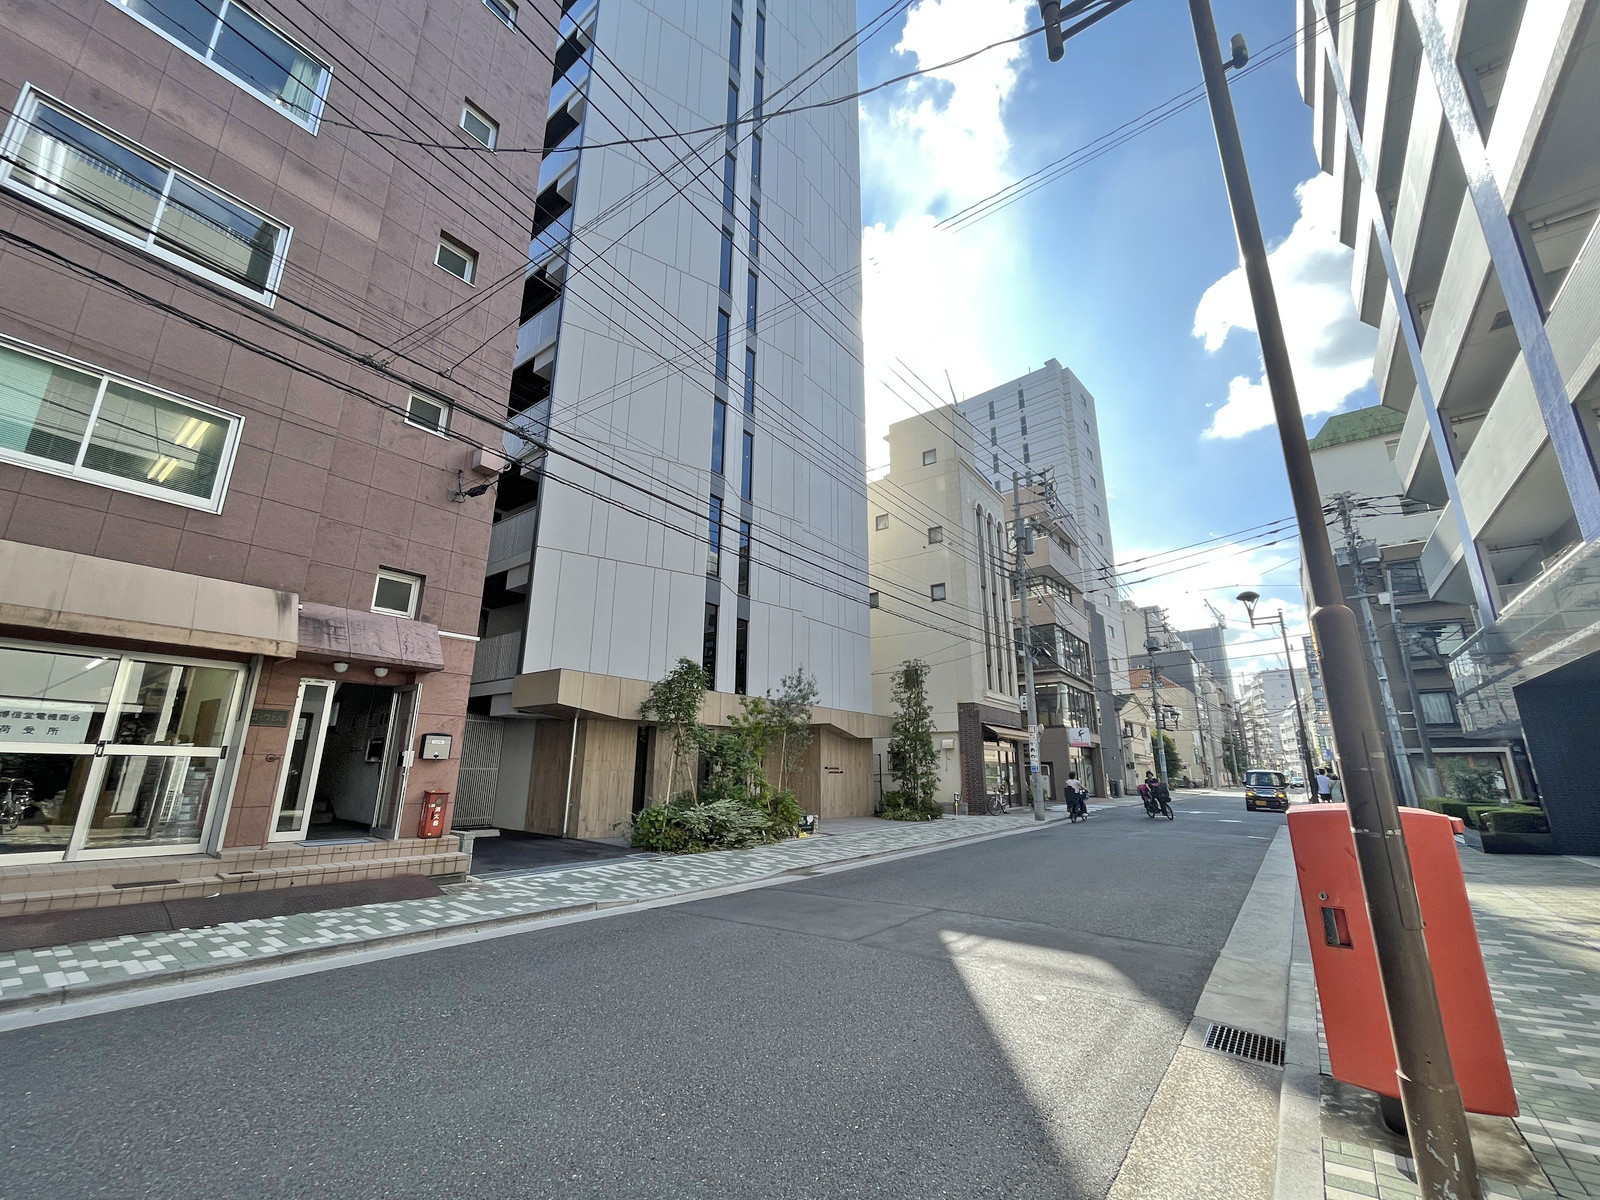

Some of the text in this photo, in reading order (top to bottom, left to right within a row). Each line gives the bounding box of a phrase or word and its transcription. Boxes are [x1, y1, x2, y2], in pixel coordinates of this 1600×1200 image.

[252, 713, 283, 722] コーワビル
[432, 806, 441, 827] 消火器
